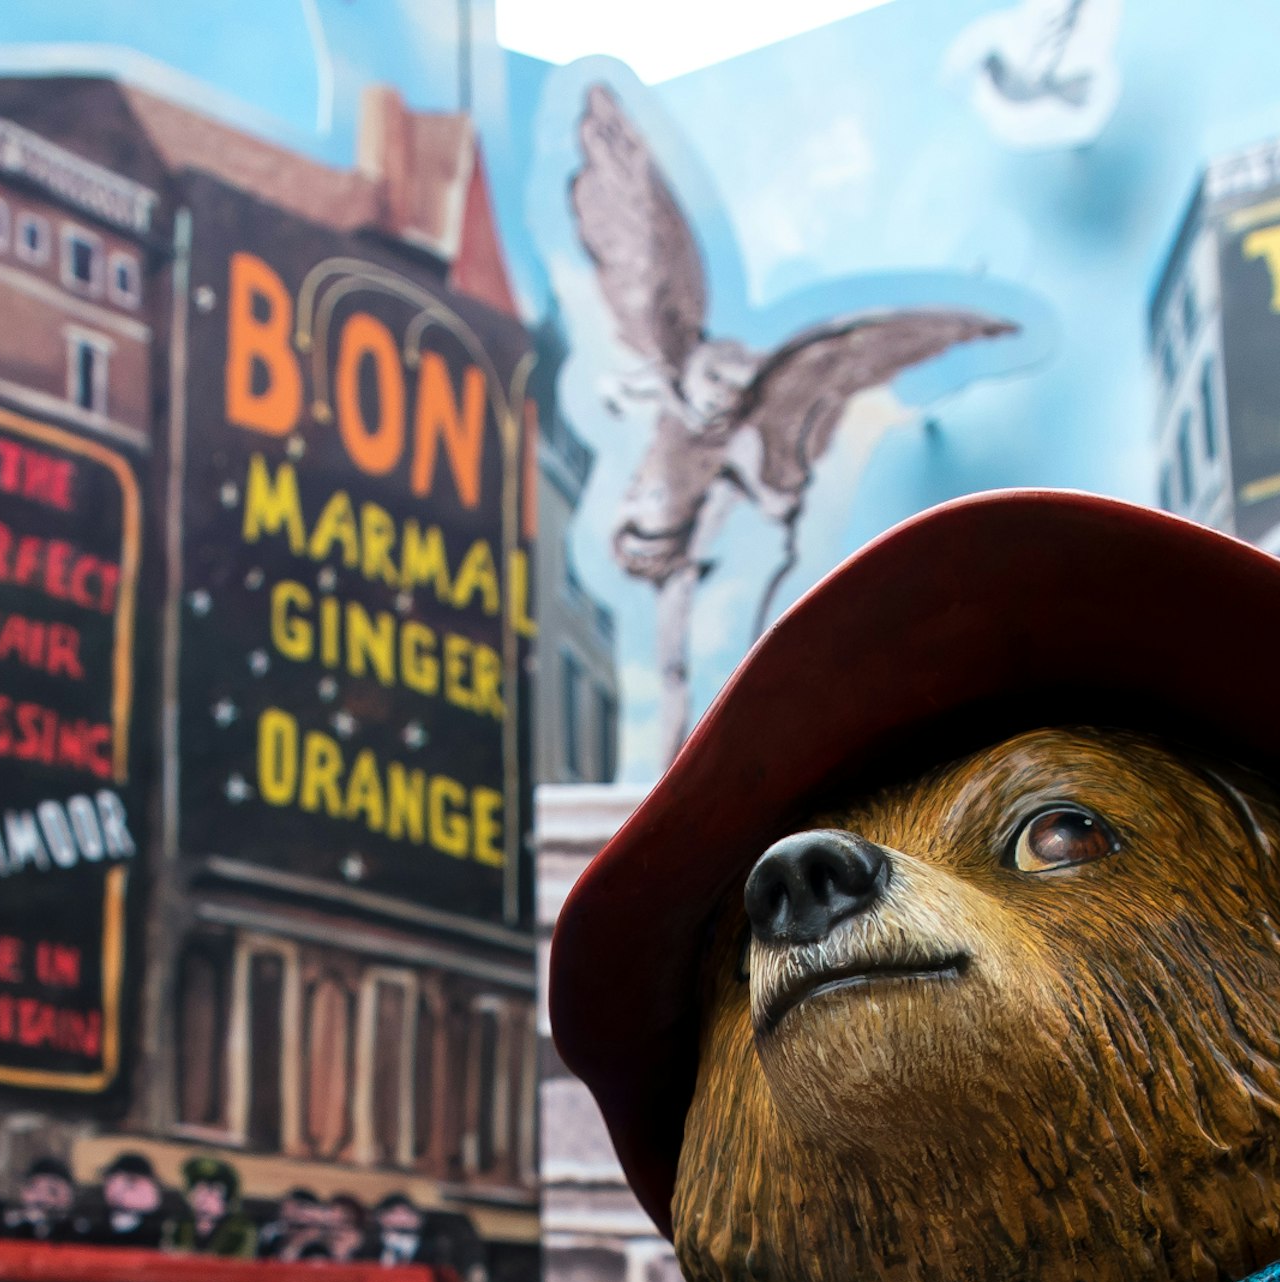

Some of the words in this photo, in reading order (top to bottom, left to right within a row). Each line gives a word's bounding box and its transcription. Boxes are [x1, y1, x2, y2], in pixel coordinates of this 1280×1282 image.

[241, 452, 538, 638] MARMAL
[270, 578, 507, 723] GINGER
[256, 706, 505, 869] ORANGE
[34, 940, 81, 989] IN
